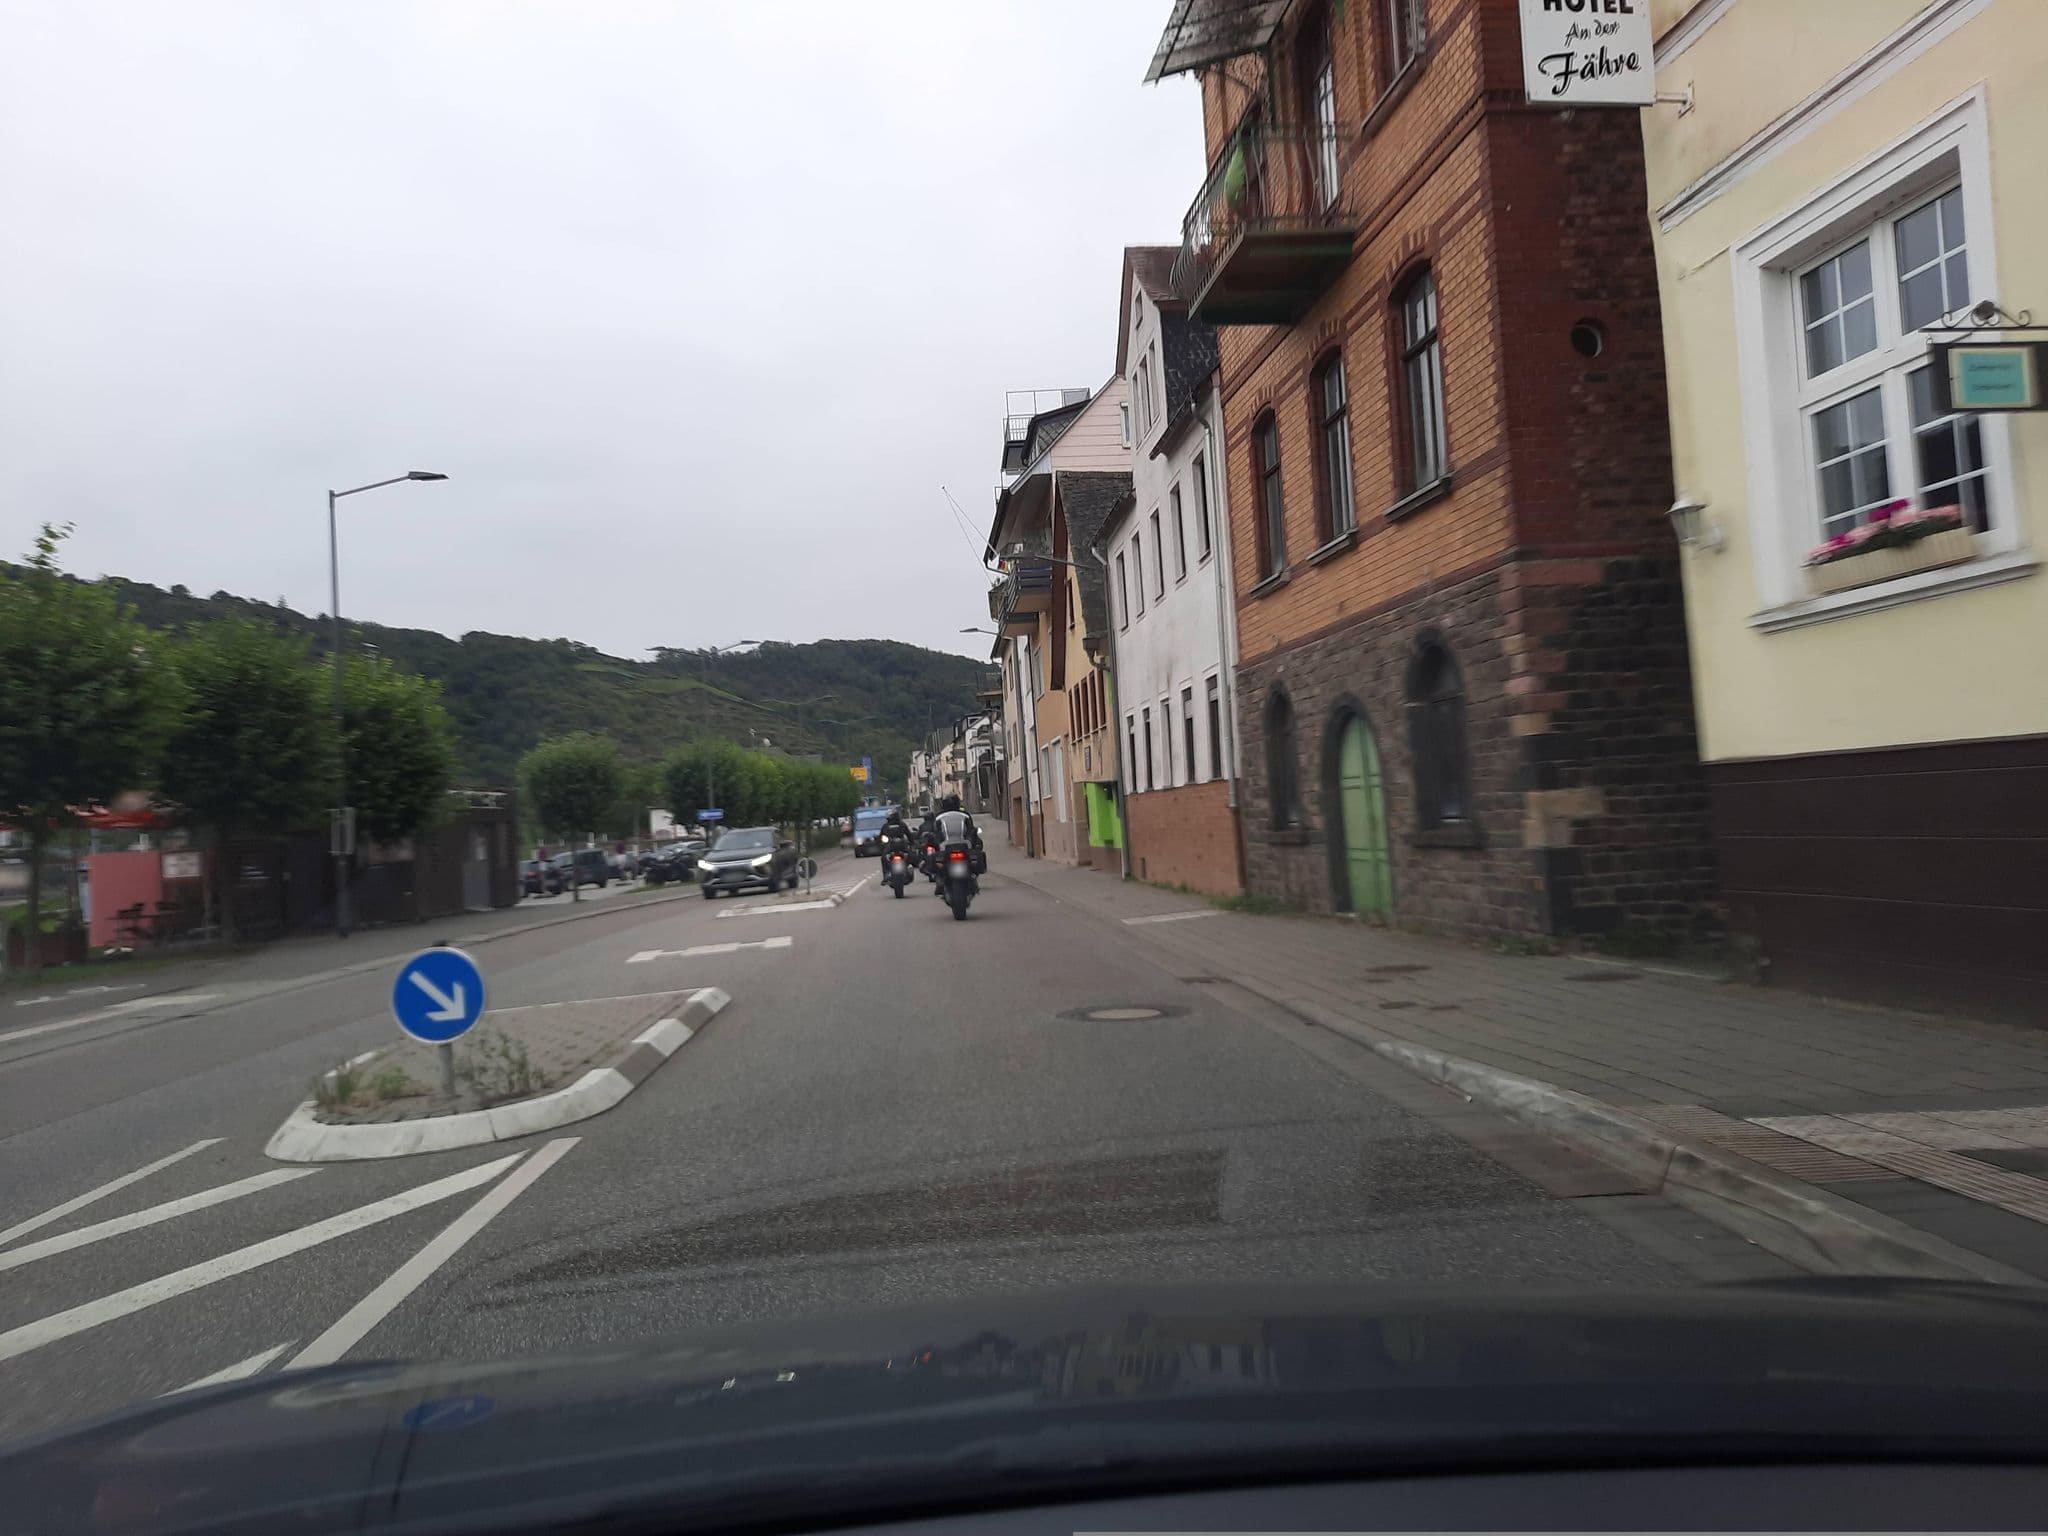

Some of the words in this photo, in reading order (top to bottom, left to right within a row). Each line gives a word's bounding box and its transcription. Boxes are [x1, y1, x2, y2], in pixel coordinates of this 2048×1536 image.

[1564, 21, 1590, 48] An
[1594, 19, 1620, 36] der
[1538, 45, 1642, 96] Fähre
